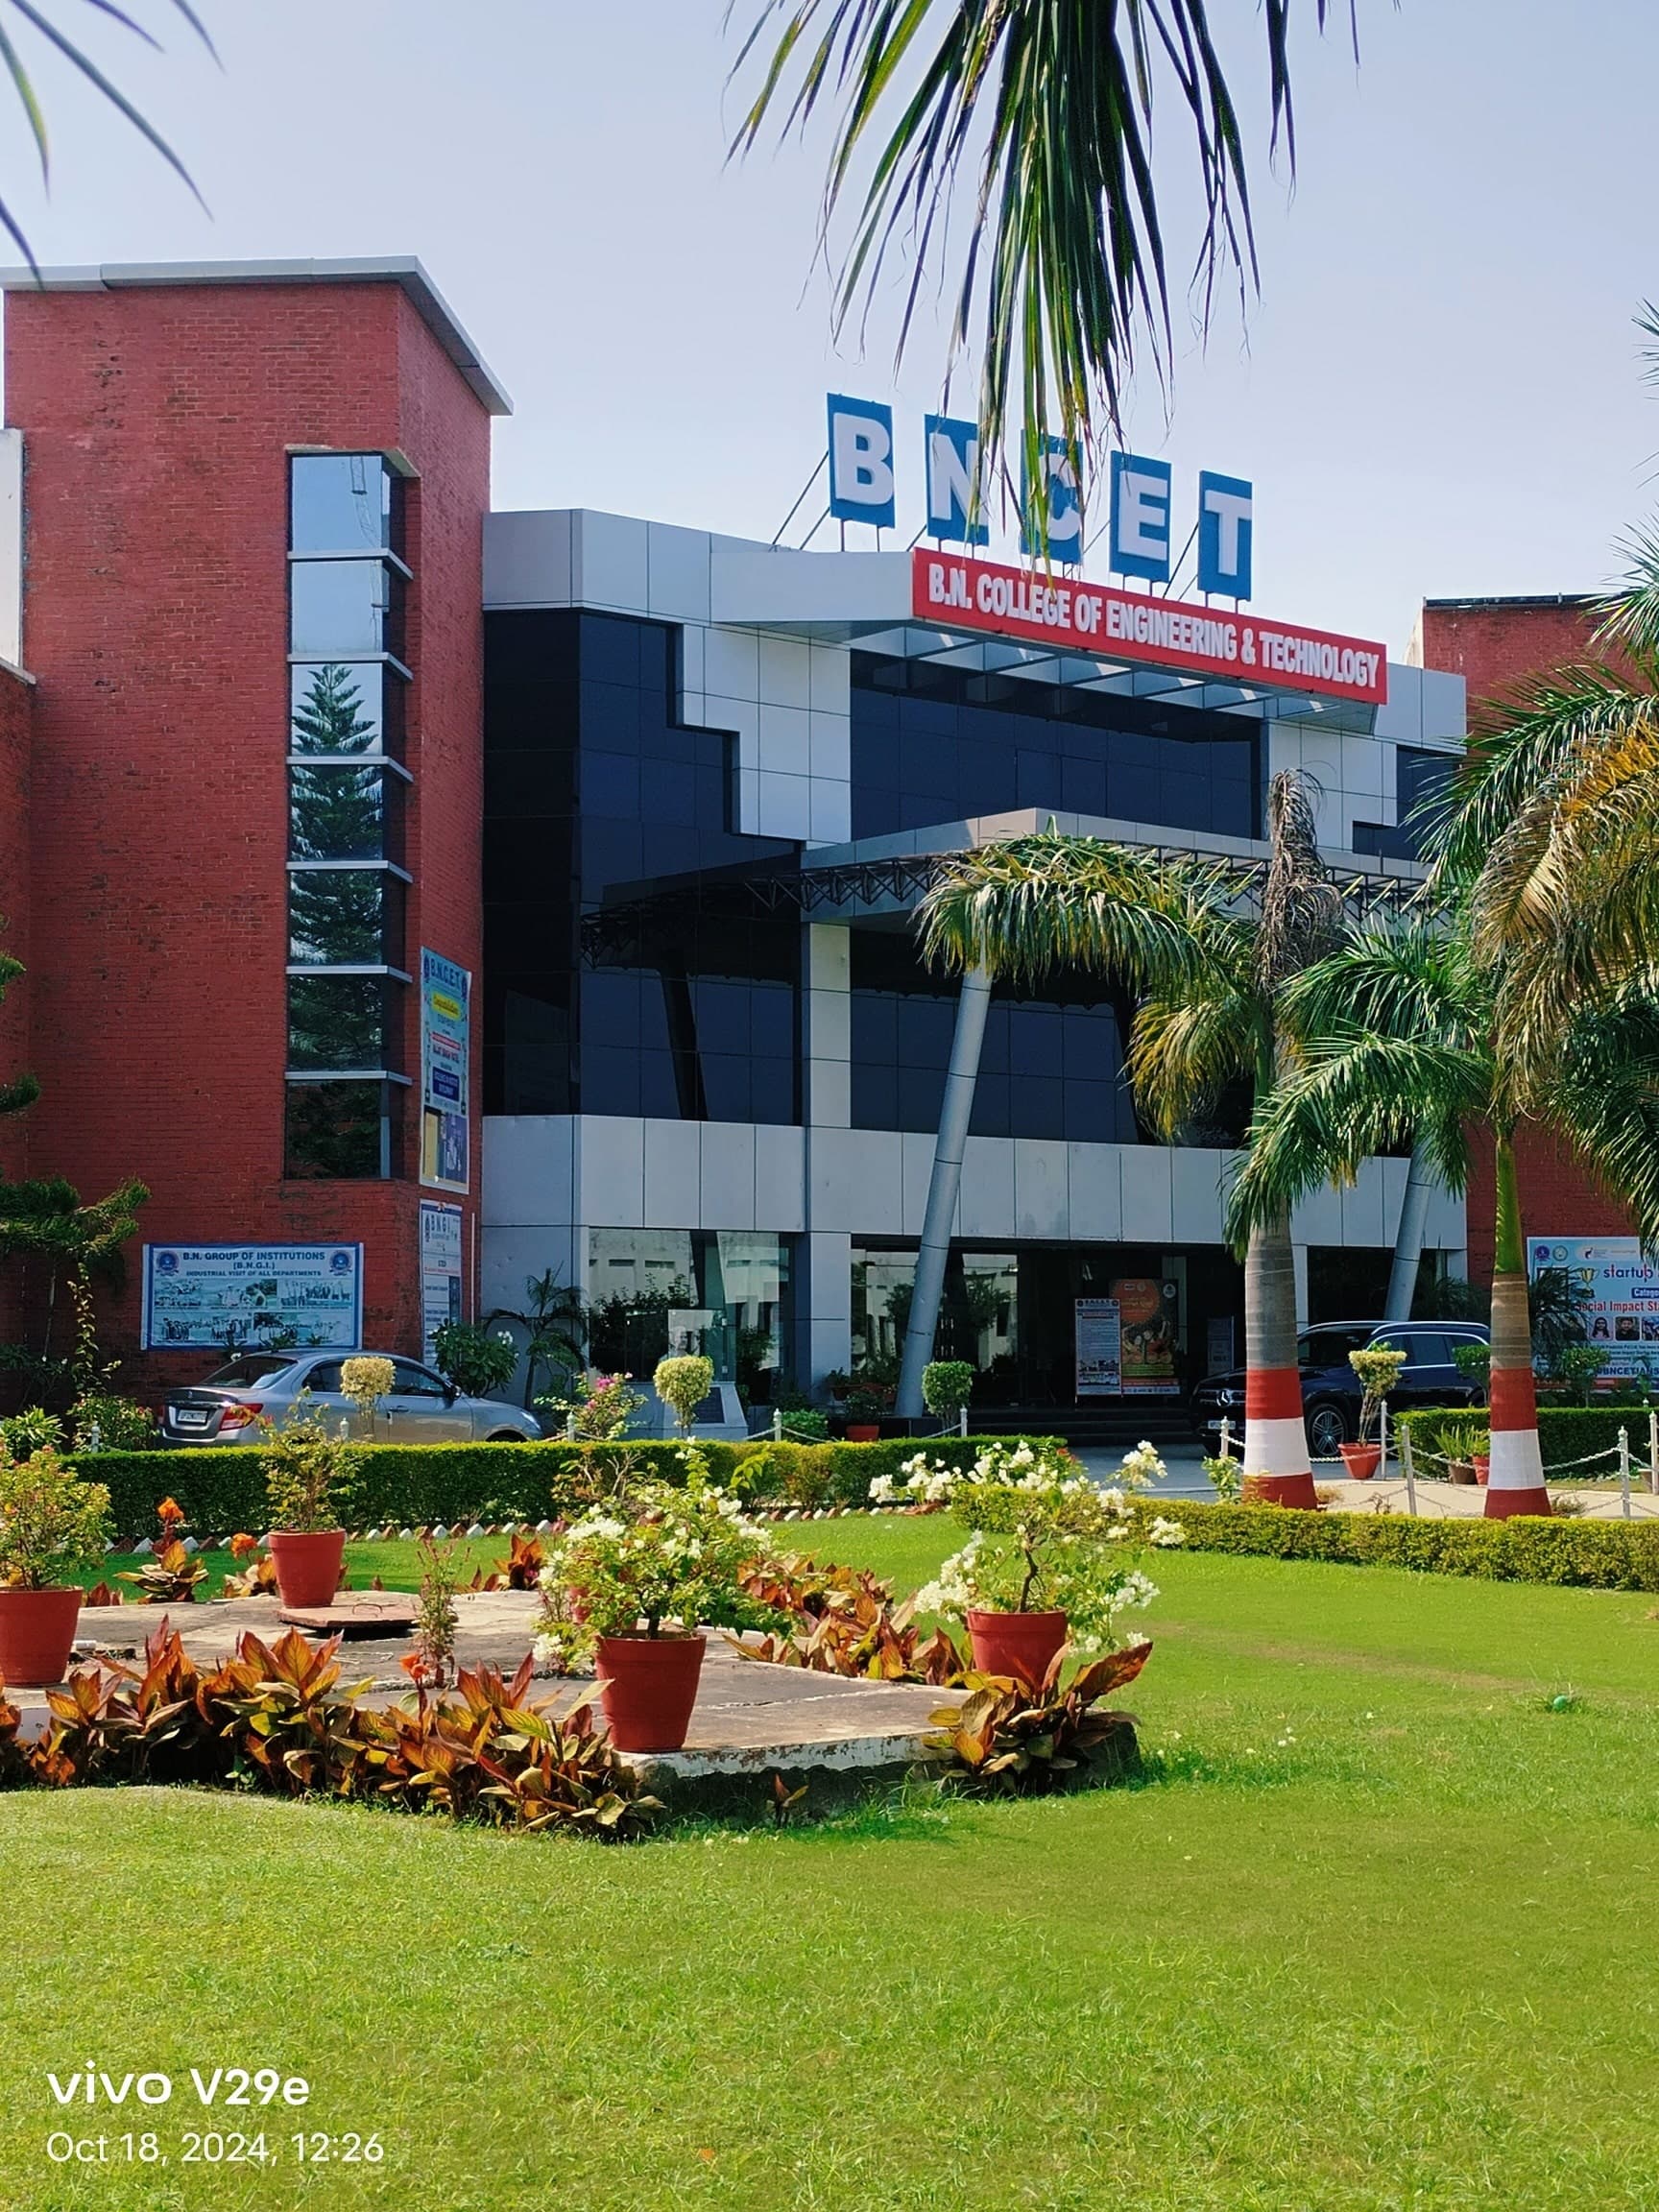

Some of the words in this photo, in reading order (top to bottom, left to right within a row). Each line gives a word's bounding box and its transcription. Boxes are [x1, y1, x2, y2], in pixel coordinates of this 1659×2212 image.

[928, 564, 972, 610] B.N.
[976, 573, 1070, 629] COLLEGE
[1074, 593, 1102, 634] OF
[1106, 599, 1238, 661] ENGINEERING
[1240, 627, 1257, 665] &
[1259, 631, 1380, 688] TECHNOLOGY
[182, 1252, 203, 1261] B.N.
[204, 1252, 239, 1261] GROUP
[241, 1252, 254, 1261] OF
[256, 1251, 325, 1261] INSTITUTIONS
[1602, 1262, 1653, 1283] startup
[1609, 1300, 1645, 1313] Impact
